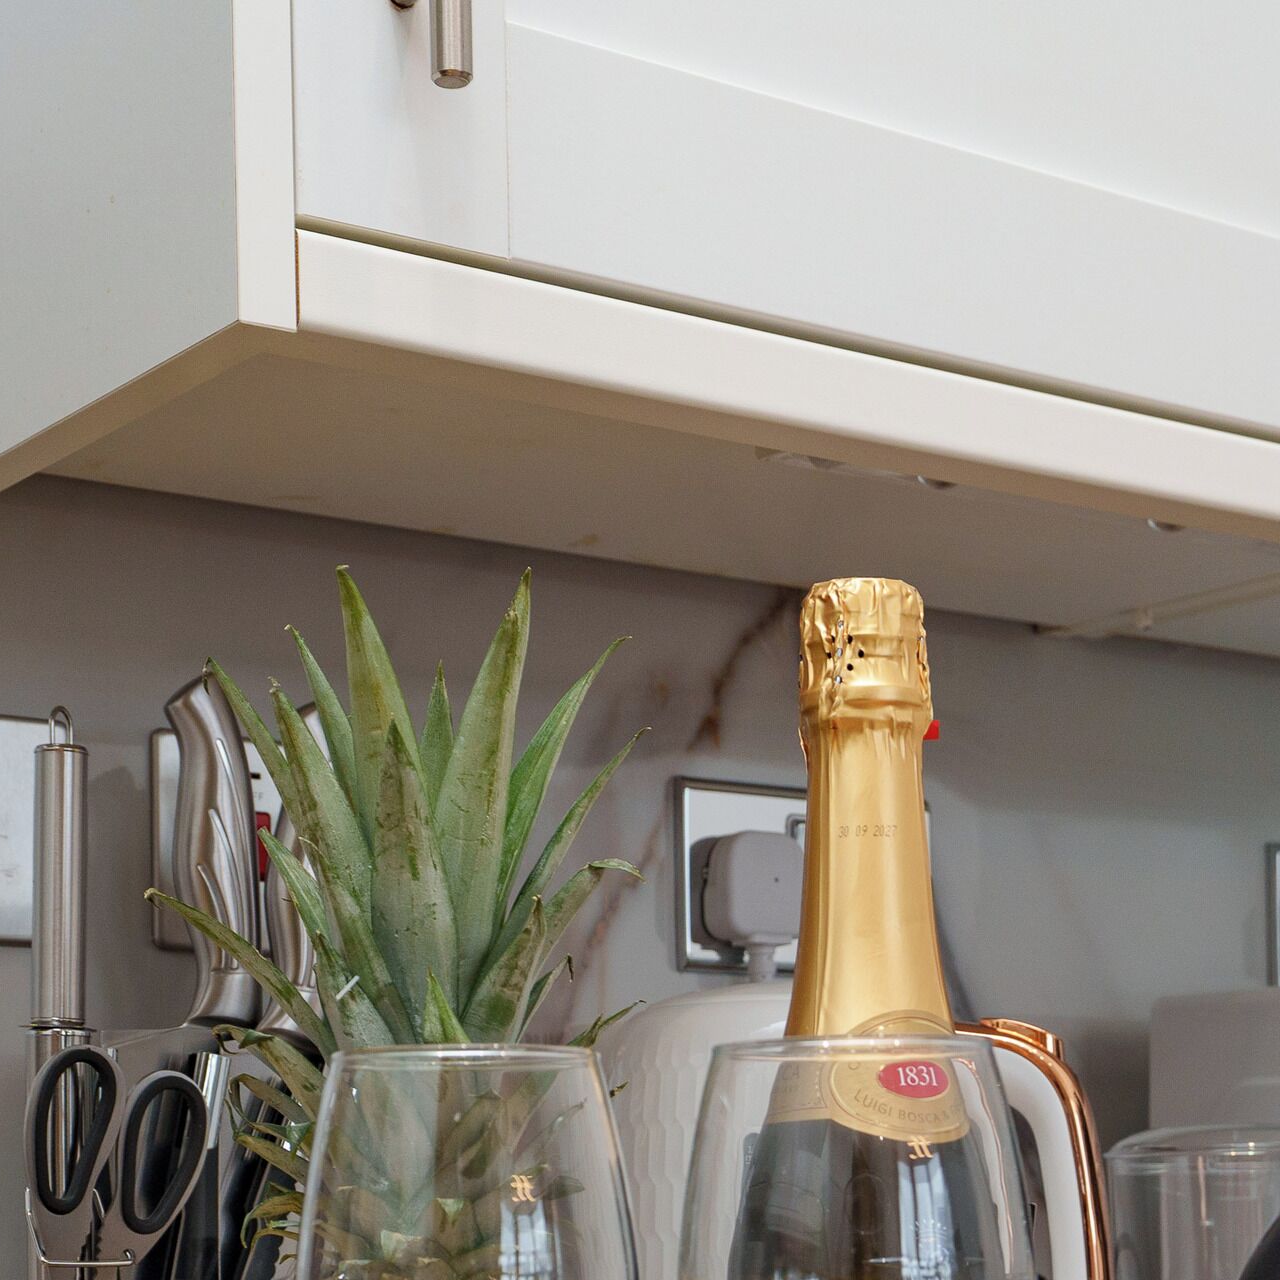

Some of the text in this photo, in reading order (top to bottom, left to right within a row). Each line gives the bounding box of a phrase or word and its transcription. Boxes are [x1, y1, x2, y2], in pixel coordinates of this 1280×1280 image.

[896, 1065, 938, 1087] 1831
[853, 1088, 893, 1117] LUIGI
[898, 1109, 941, 1123] BOSCA
